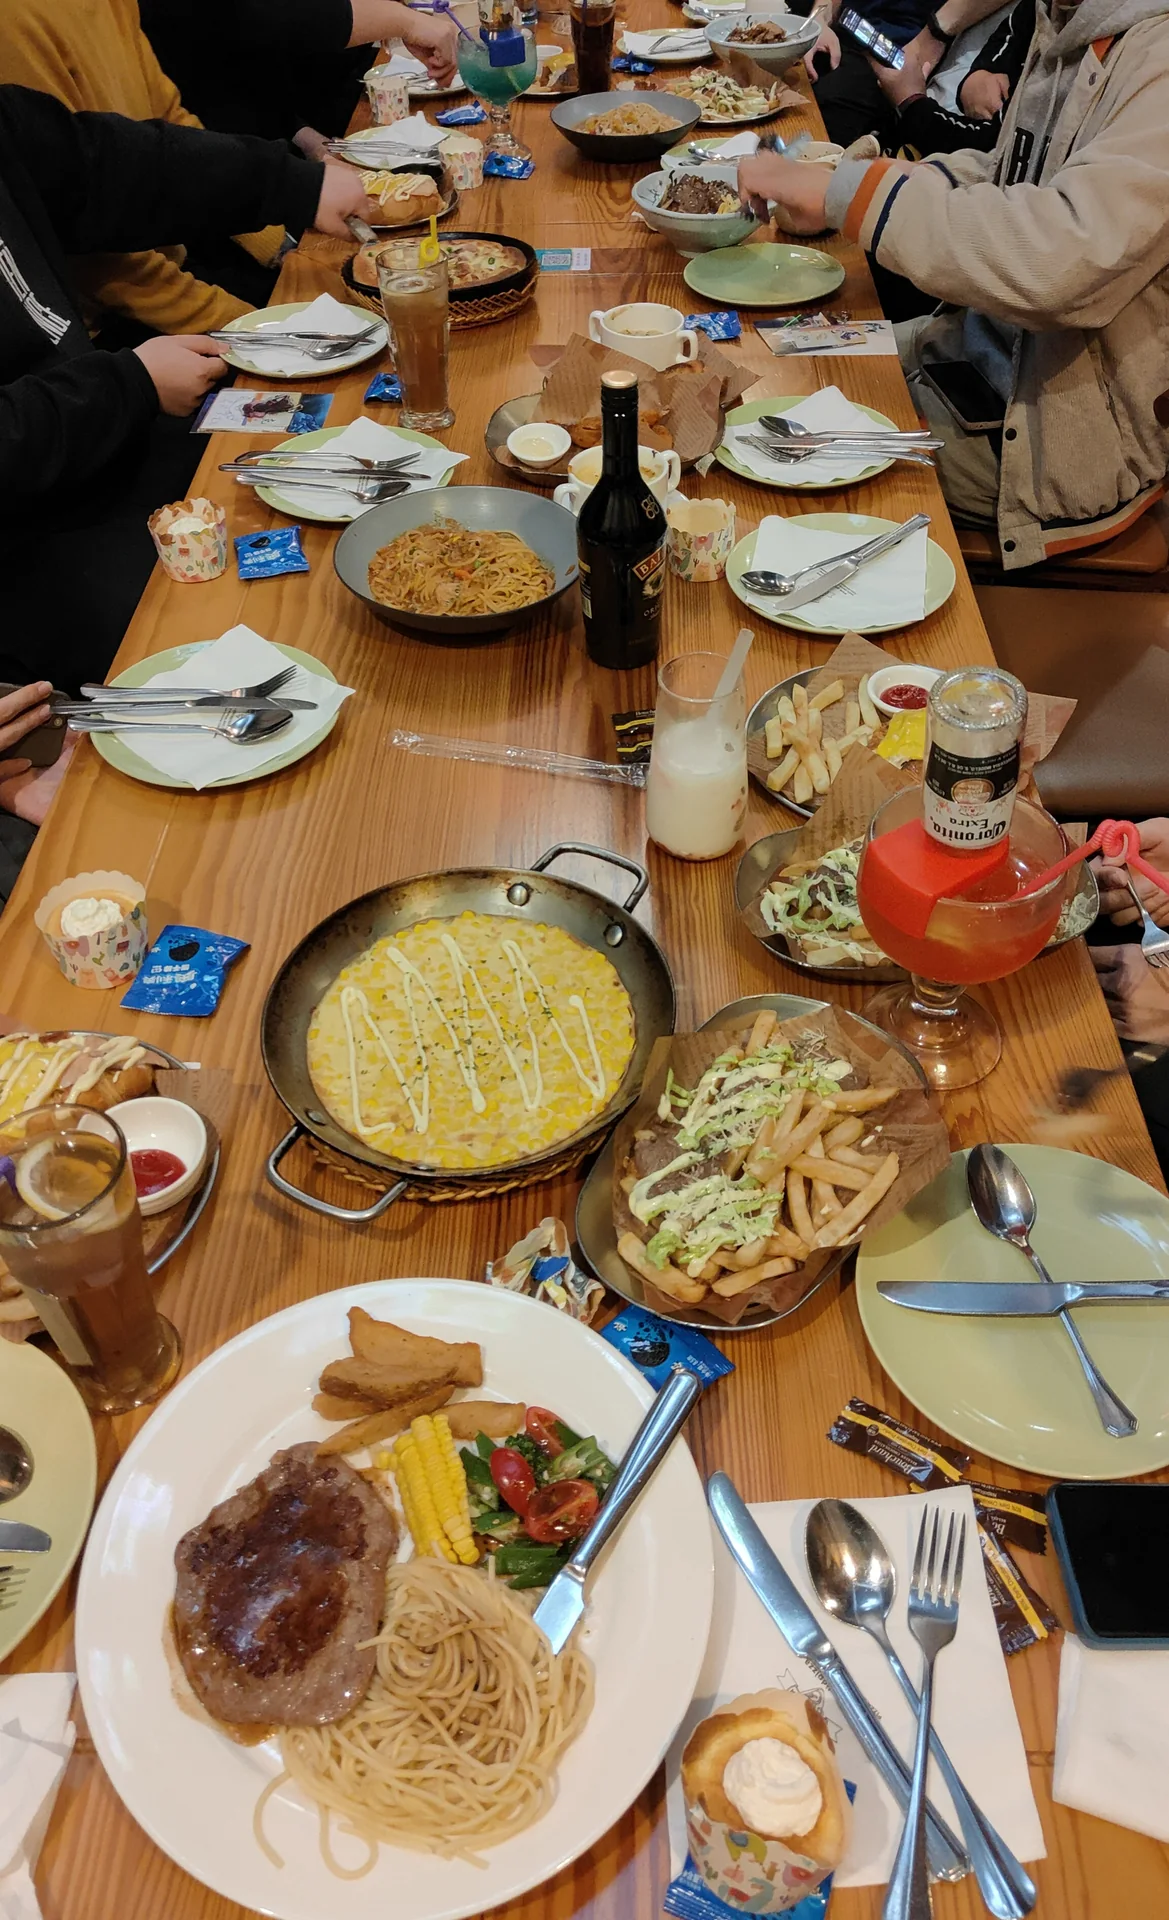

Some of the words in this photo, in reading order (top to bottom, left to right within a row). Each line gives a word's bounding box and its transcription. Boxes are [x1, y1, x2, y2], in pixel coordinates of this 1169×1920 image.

[933, 821, 1006, 841] Coronita
[949, 818, 989, 829] Extra
[868, 1444, 914, 1474] Bouchard
